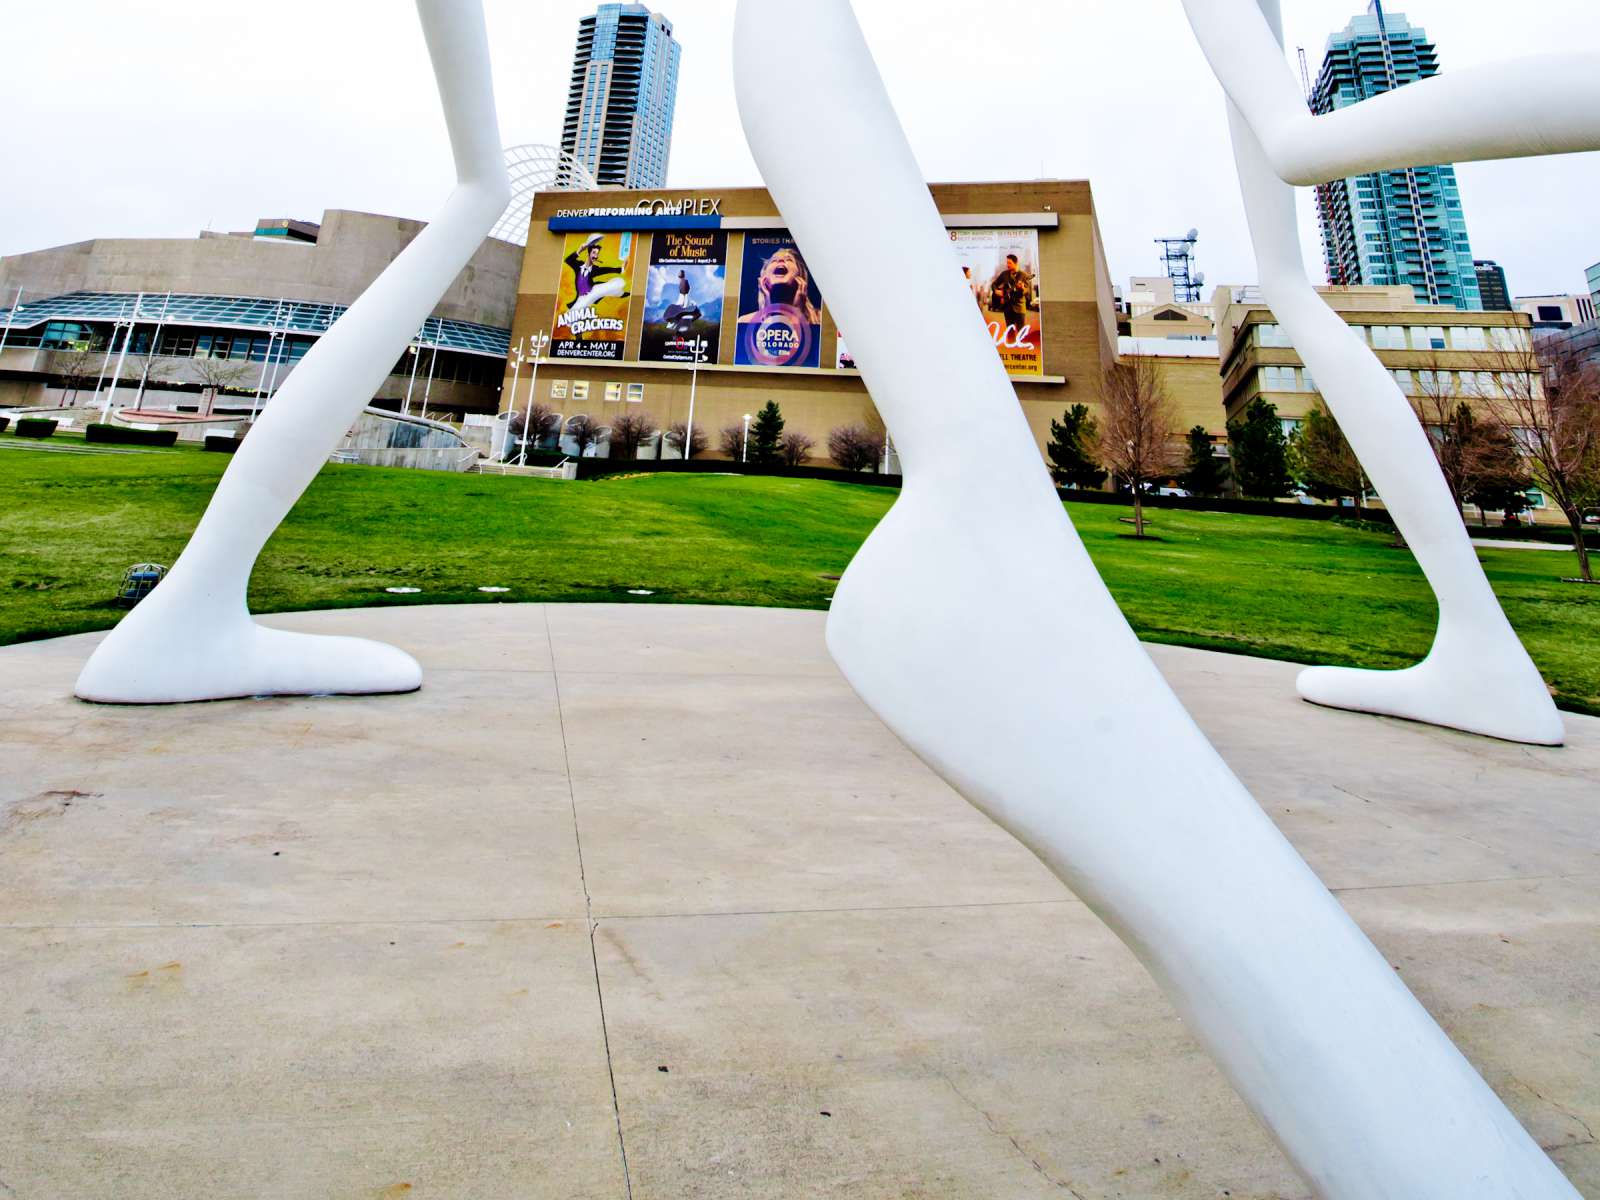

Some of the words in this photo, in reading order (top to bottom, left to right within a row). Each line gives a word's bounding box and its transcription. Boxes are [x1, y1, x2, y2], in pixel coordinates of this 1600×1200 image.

[636, 199, 721, 216] COMPLEX
[655, 207, 682, 216] ARTS
[666, 234, 682, 246] The
[684, 234, 714, 246] Sound
[669, 247, 679, 257] of
[681, 246, 707, 257] Music
[558, 307, 598, 328] ANIMAL
[571, 318, 624, 335] CRACKERS
[756, 329, 798, 341] OPERA
[559, 341, 575, 349] APR
[590, 342, 609, 350] MAY
[557, 349, 616, 357] DENVERCENTER.ORG
